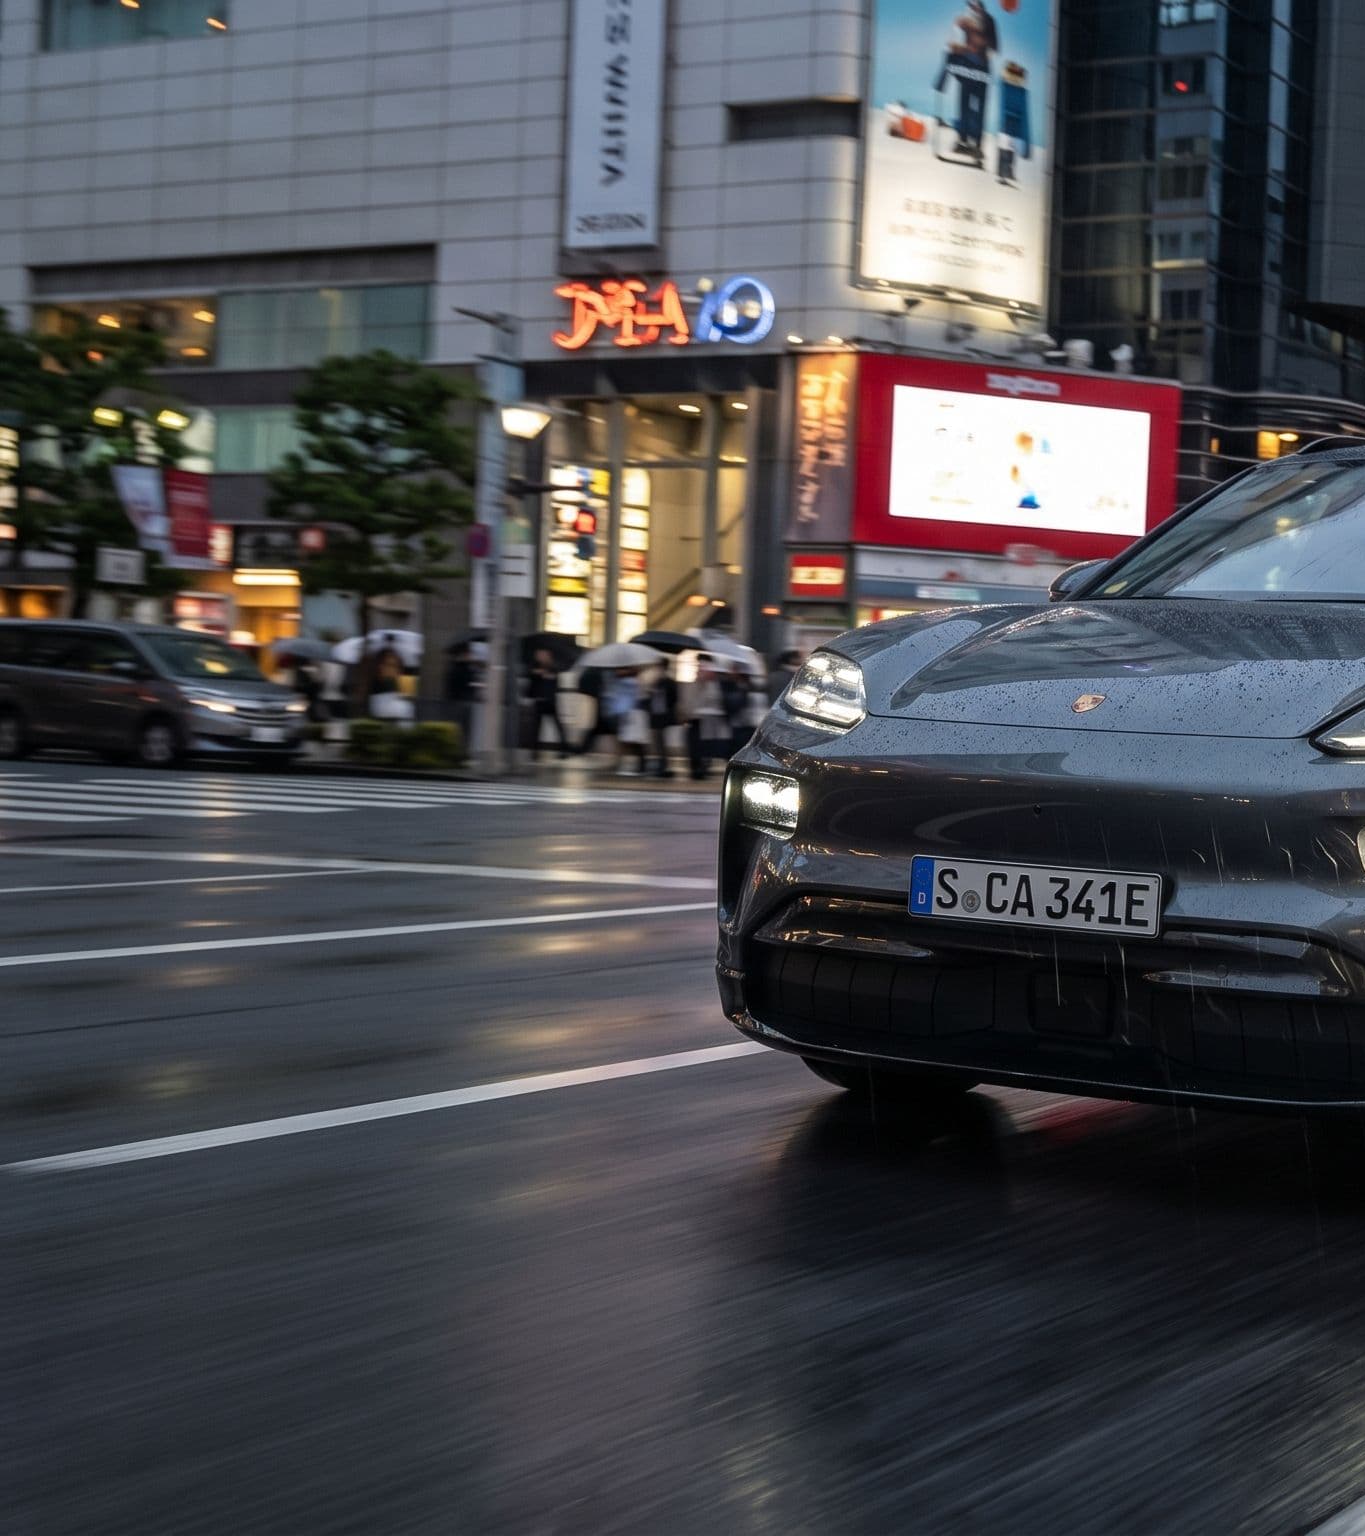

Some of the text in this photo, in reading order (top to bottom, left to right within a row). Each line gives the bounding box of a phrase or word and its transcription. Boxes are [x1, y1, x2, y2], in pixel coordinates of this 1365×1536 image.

[918, 892, 926, 904] D
[935, 867, 959, 910] S
[986, 872, 1035, 918] CA
[1045, 876, 1150, 927] 341E
